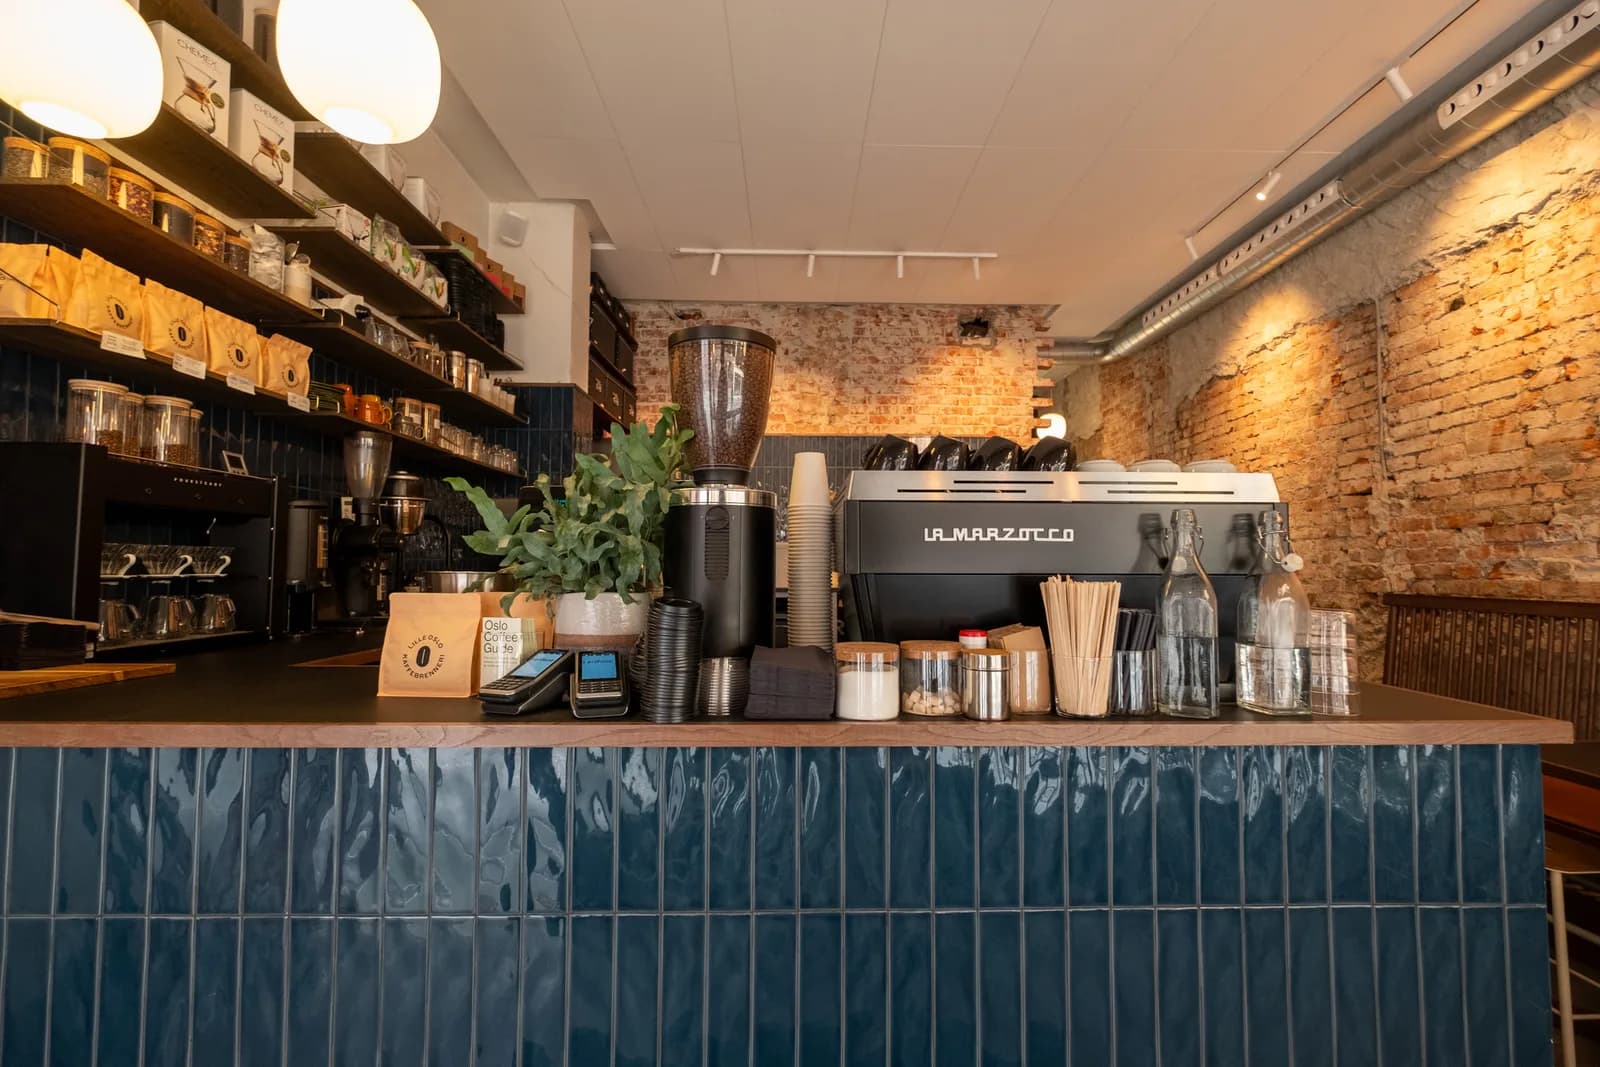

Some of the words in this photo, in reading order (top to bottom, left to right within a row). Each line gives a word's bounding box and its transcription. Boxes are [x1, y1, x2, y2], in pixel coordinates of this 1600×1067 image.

[176, 38, 218, 67] CHEMEX
[924, 527, 944, 541] LA
[952, 527, 1074, 542] MARZOCCO
[484, 619, 508, 631] Oslo
[407, 635, 427, 649] LILLE
[427, 634, 444, 649] OSLO
[483, 631, 518, 642] Coffee
[402, 653, 445, 679] KAFFEBRENNERI
